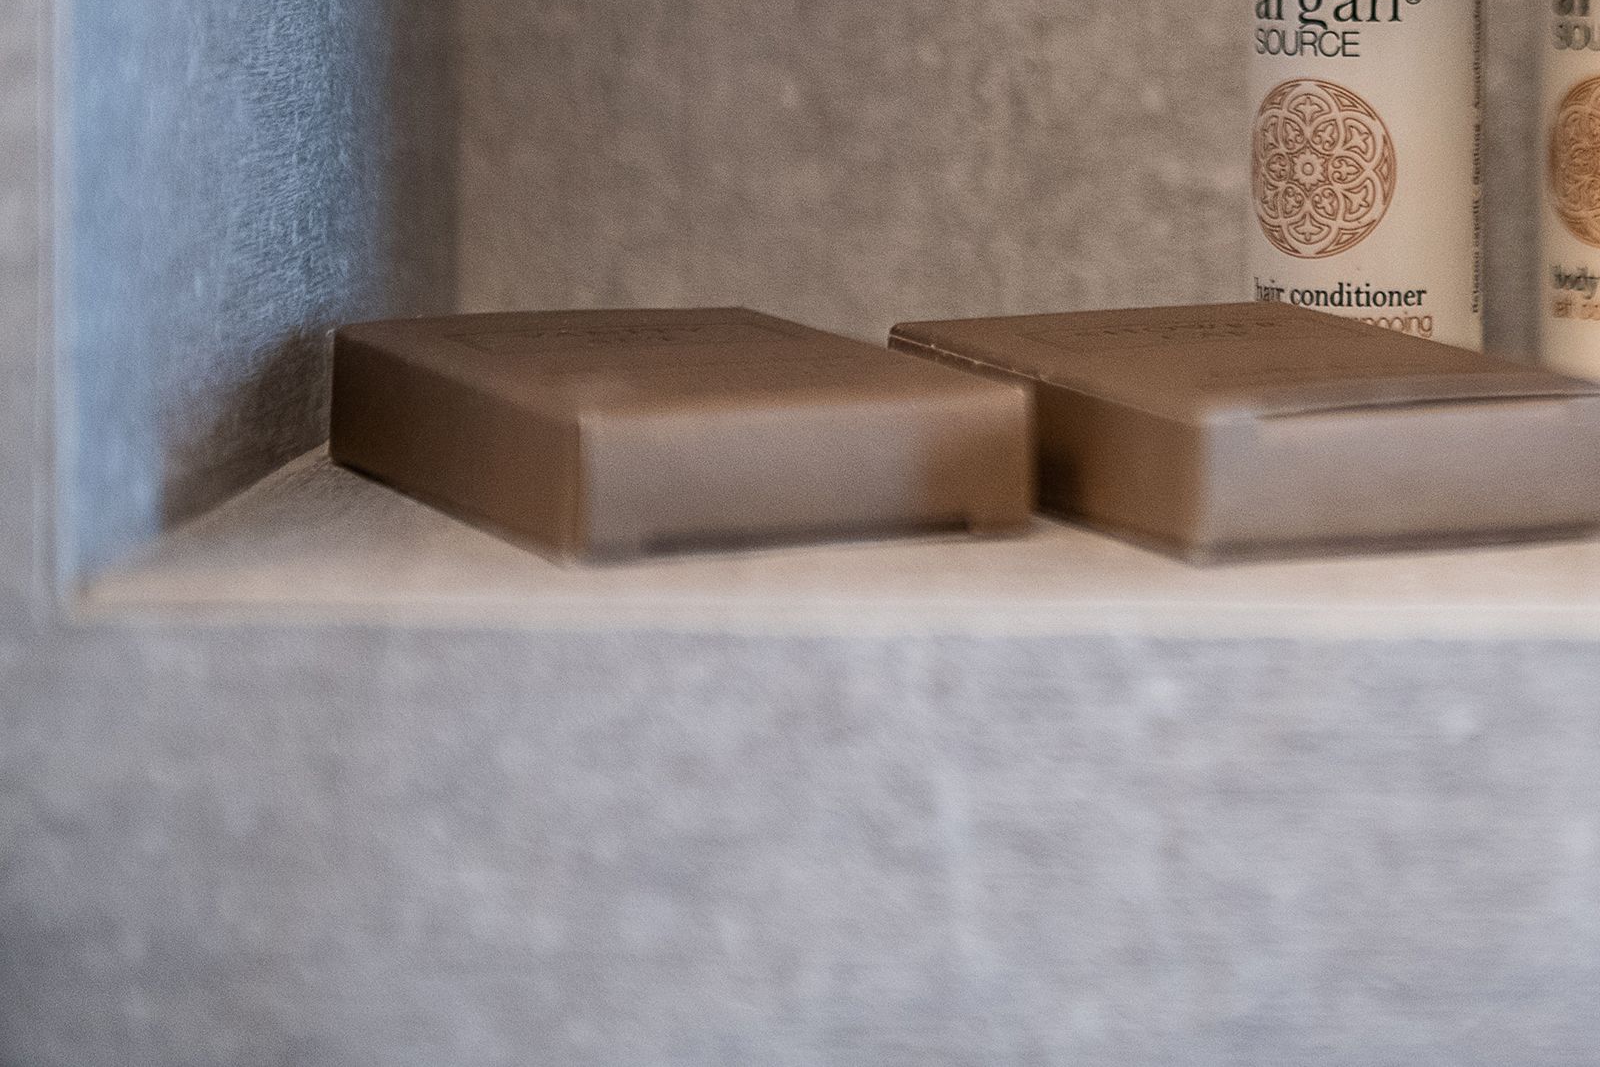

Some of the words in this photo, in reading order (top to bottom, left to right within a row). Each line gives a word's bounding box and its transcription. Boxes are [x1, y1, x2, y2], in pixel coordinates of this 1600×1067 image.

[1255, 27, 1360, 57] SOURCE
[1254, 277, 1285, 302] hair
[1290, 282, 1427, 308] conditioner
[1552, 264, 1600, 300] body
